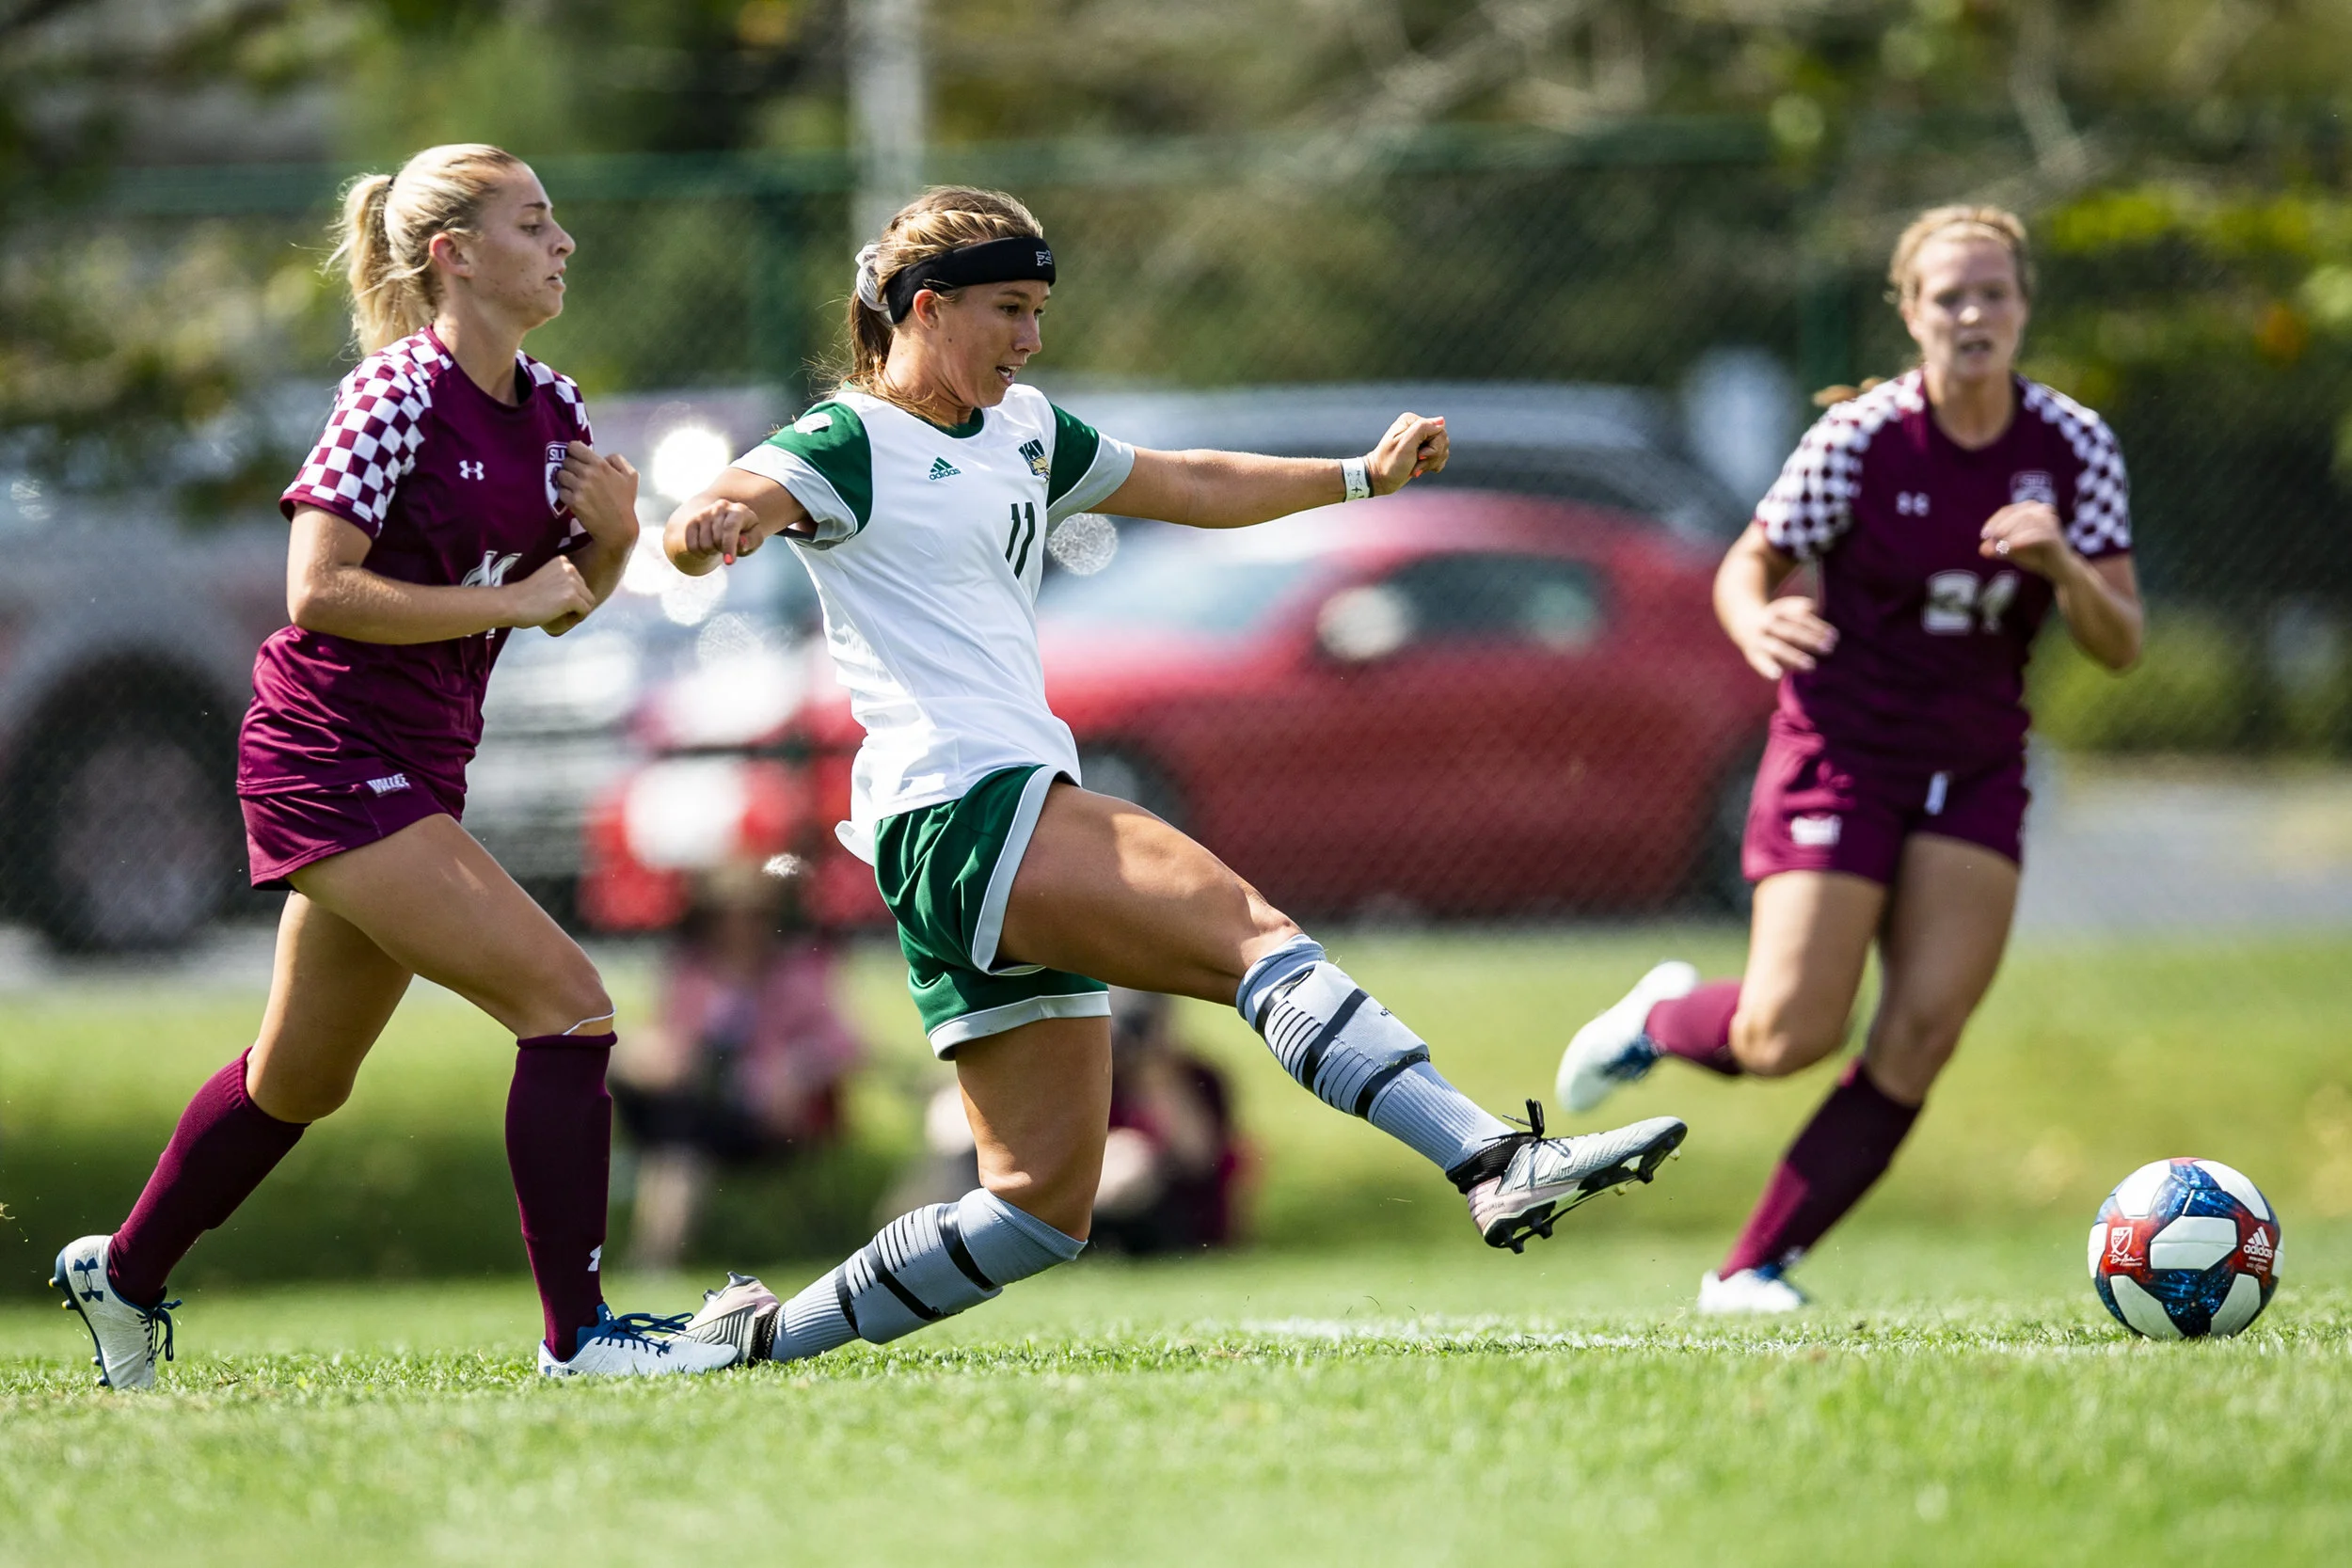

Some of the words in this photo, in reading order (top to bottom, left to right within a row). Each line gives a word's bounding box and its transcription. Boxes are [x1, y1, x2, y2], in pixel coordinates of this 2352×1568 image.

[929, 467, 961, 481] adidas
[1005, 501, 1036, 580] 11
[1920, 568, 2021, 636] 21
[2243, 1243, 2273, 1259] adidas
